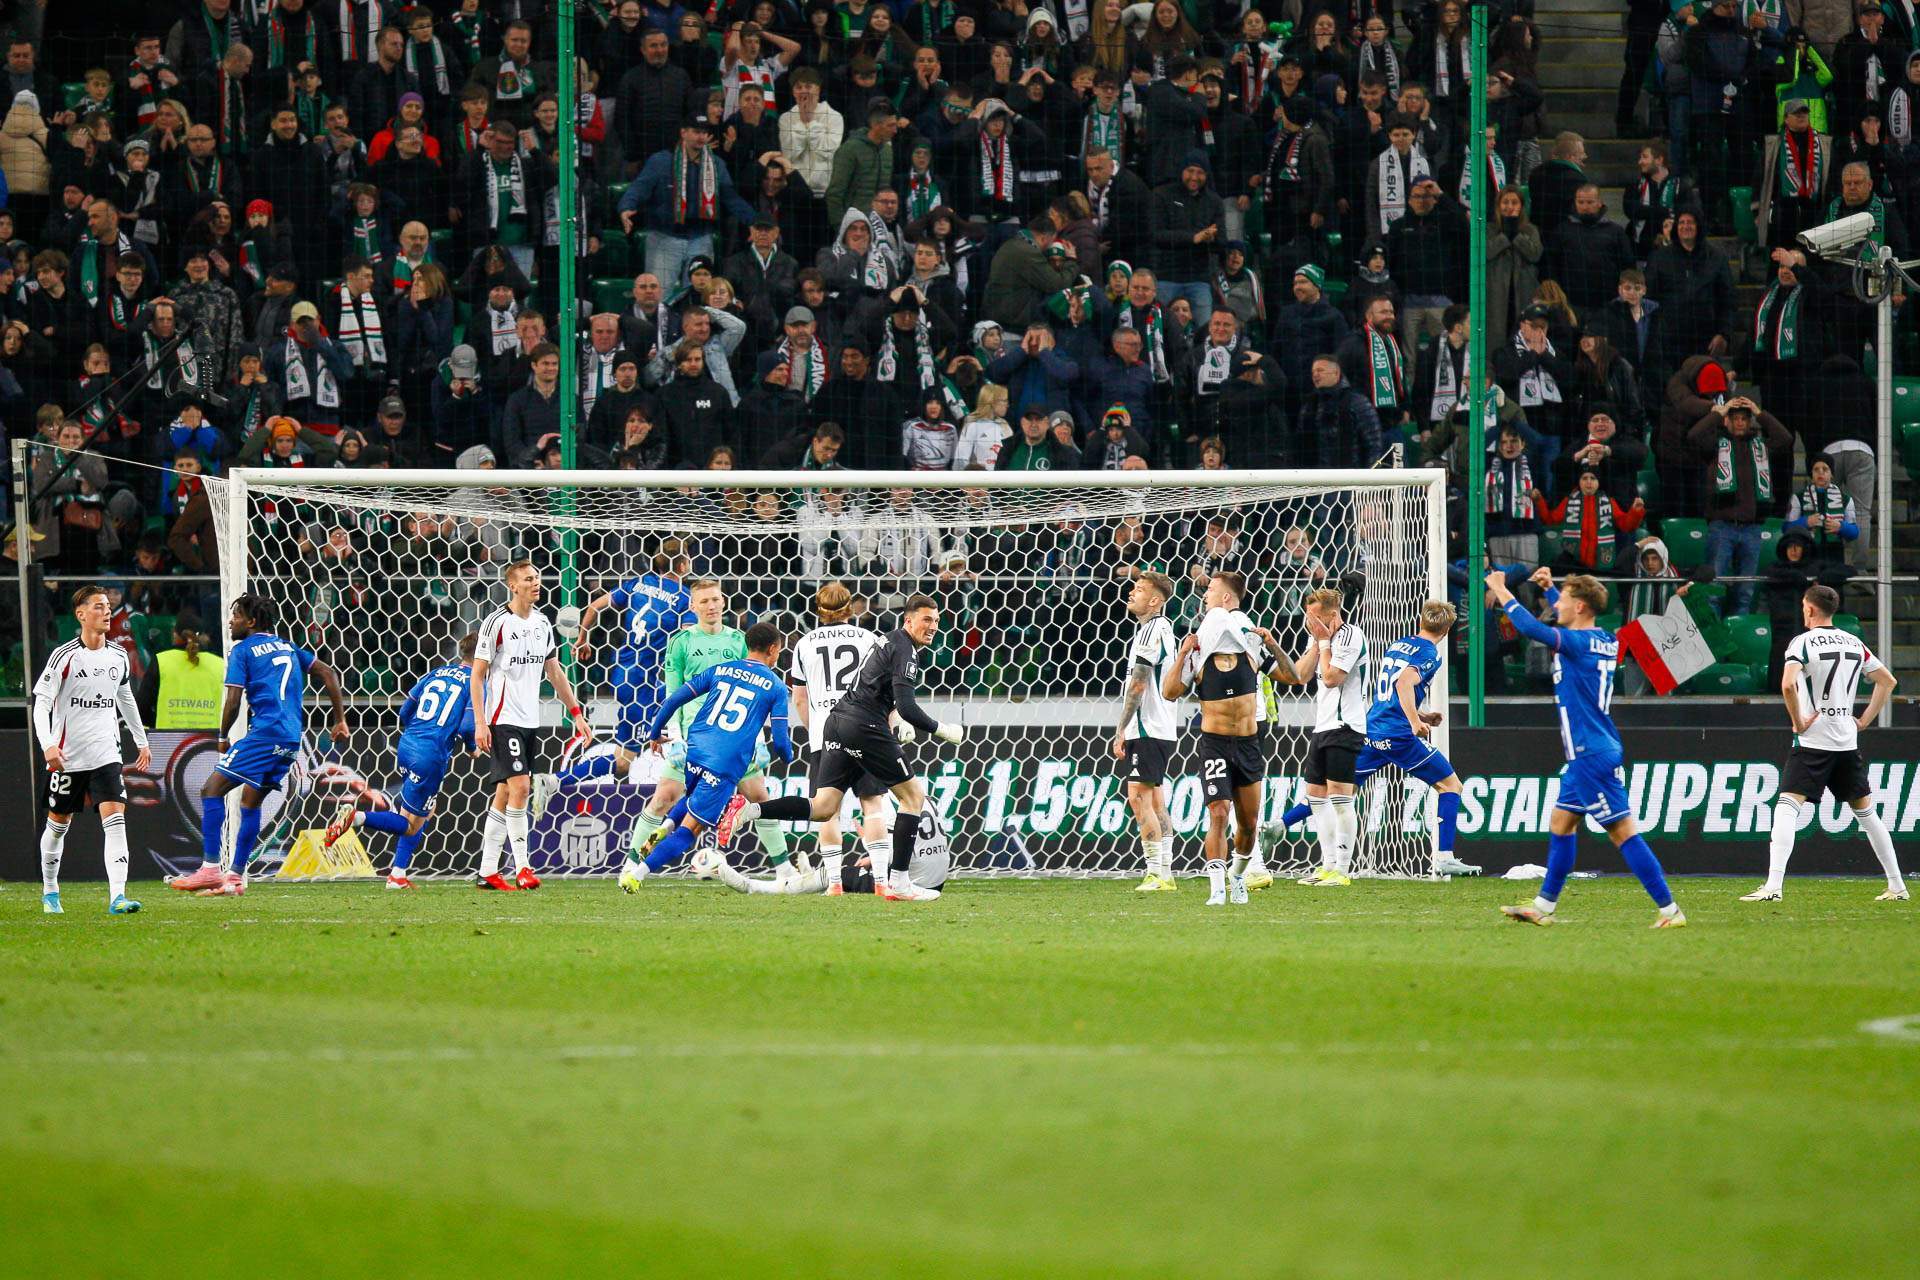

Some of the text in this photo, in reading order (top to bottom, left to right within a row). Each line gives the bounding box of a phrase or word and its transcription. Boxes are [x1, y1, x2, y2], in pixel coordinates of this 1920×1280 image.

[631, 602, 651, 645] 4
[271, 655, 292, 701] 7
[714, 665, 773, 691] MASSIMO
[816, 644, 860, 692] 12
[1378, 656, 1410, 701] 67
[1819, 651, 1862, 701] 77
[168, 699, 216, 709] STEWARD
[416, 679, 462, 727] 61
[705, 681, 756, 732] 15
[818, 698, 841, 708] FOR
[1821, 707, 1851, 717] FORT
[508, 737, 521, 756] 9
[49, 770, 72, 796] 82
[1204, 758, 1227, 781] 22
[984, 760, 1125, 834] 1.5%
